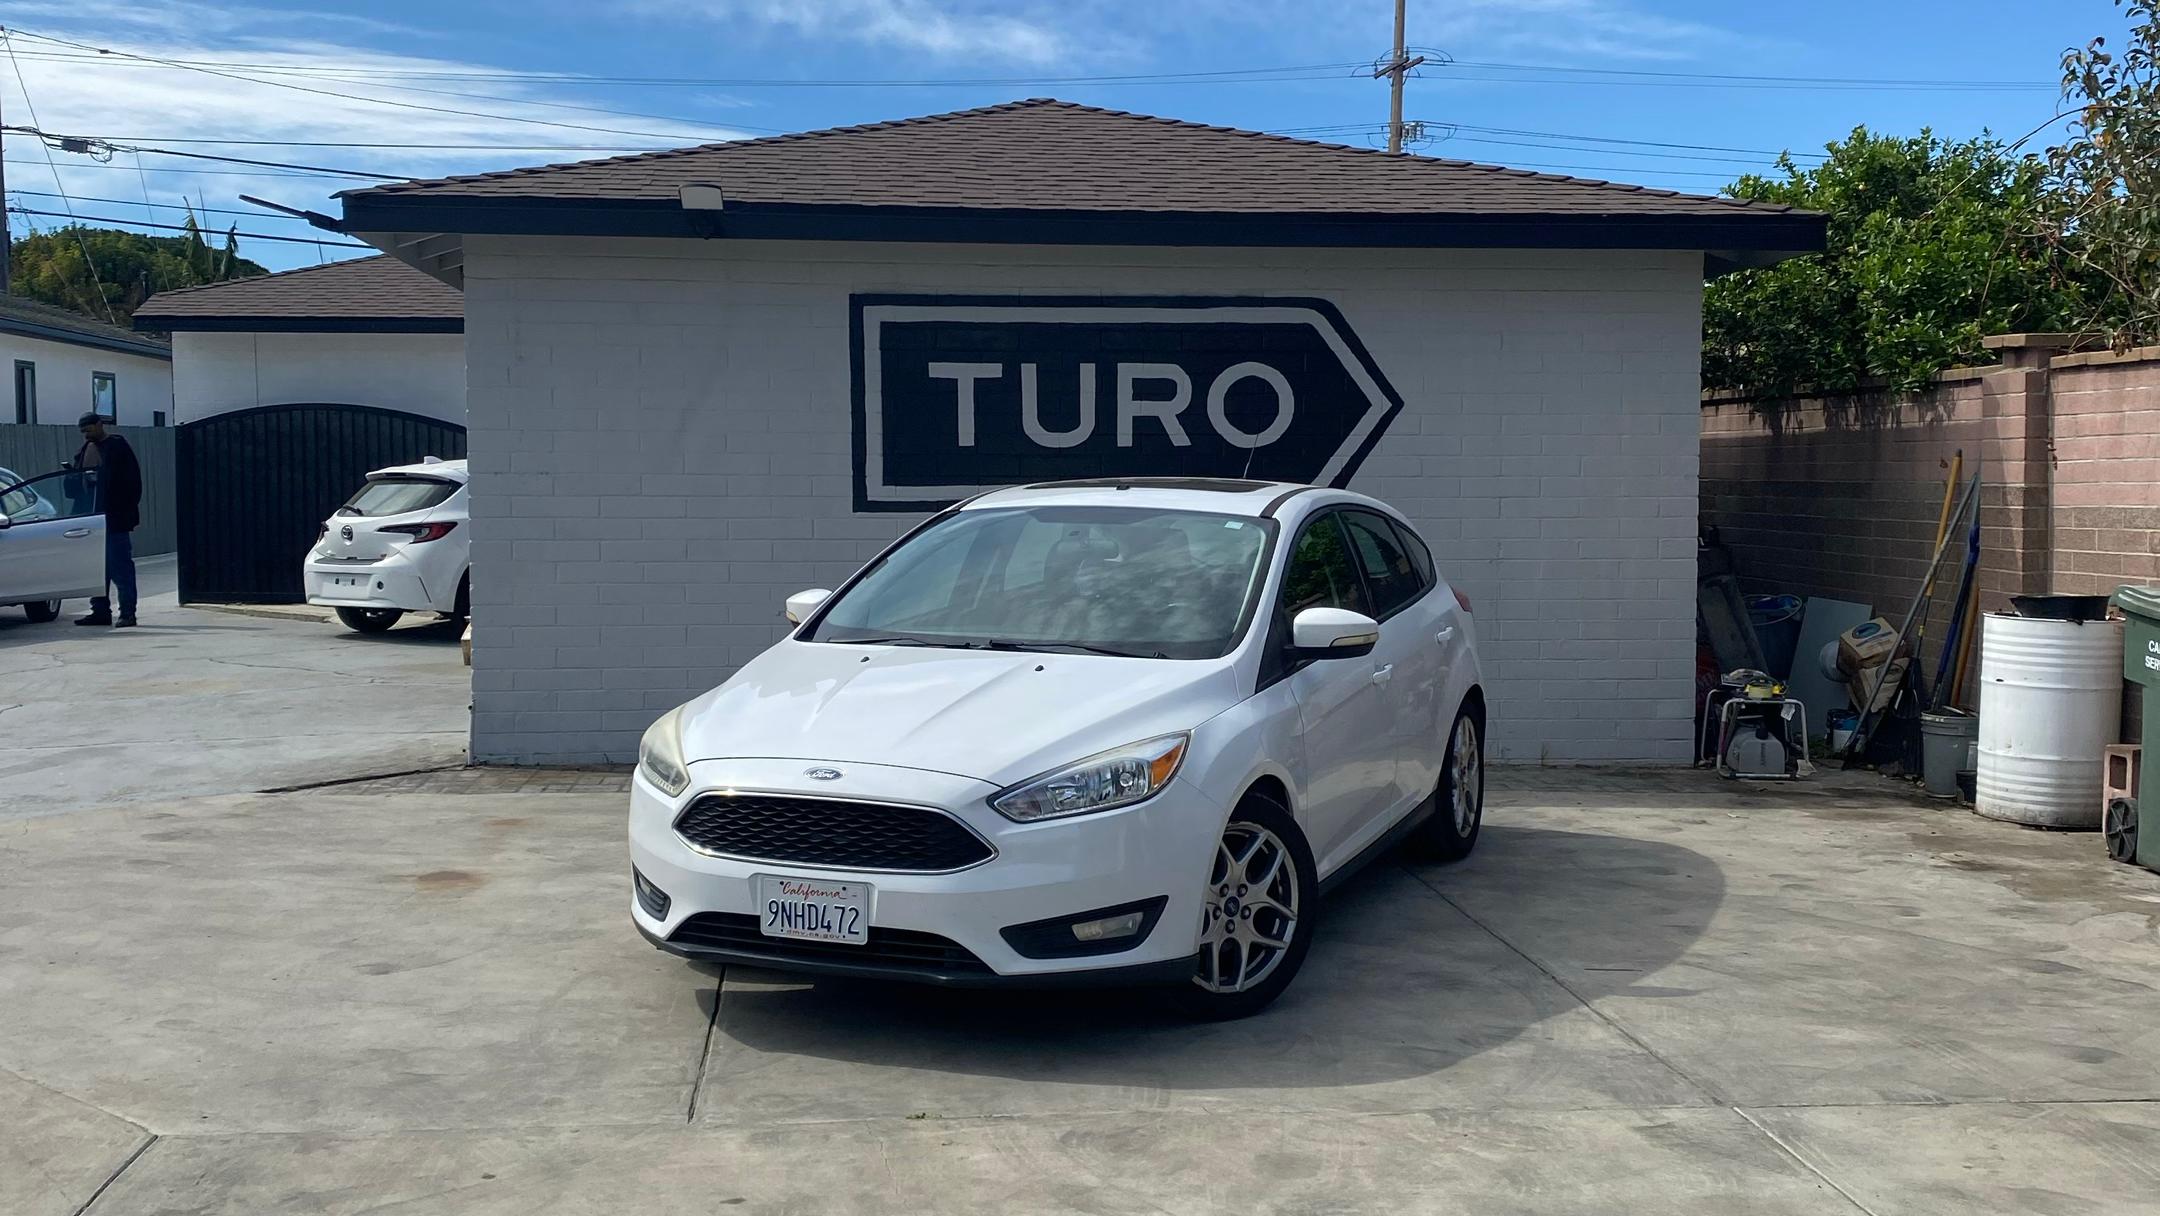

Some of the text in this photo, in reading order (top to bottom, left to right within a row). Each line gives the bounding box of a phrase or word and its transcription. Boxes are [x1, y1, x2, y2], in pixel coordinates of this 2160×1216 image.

[928, 362, 1295, 449] TURO
[783, 881, 847, 900] California
[767, 899, 860, 935] 9NHD472
